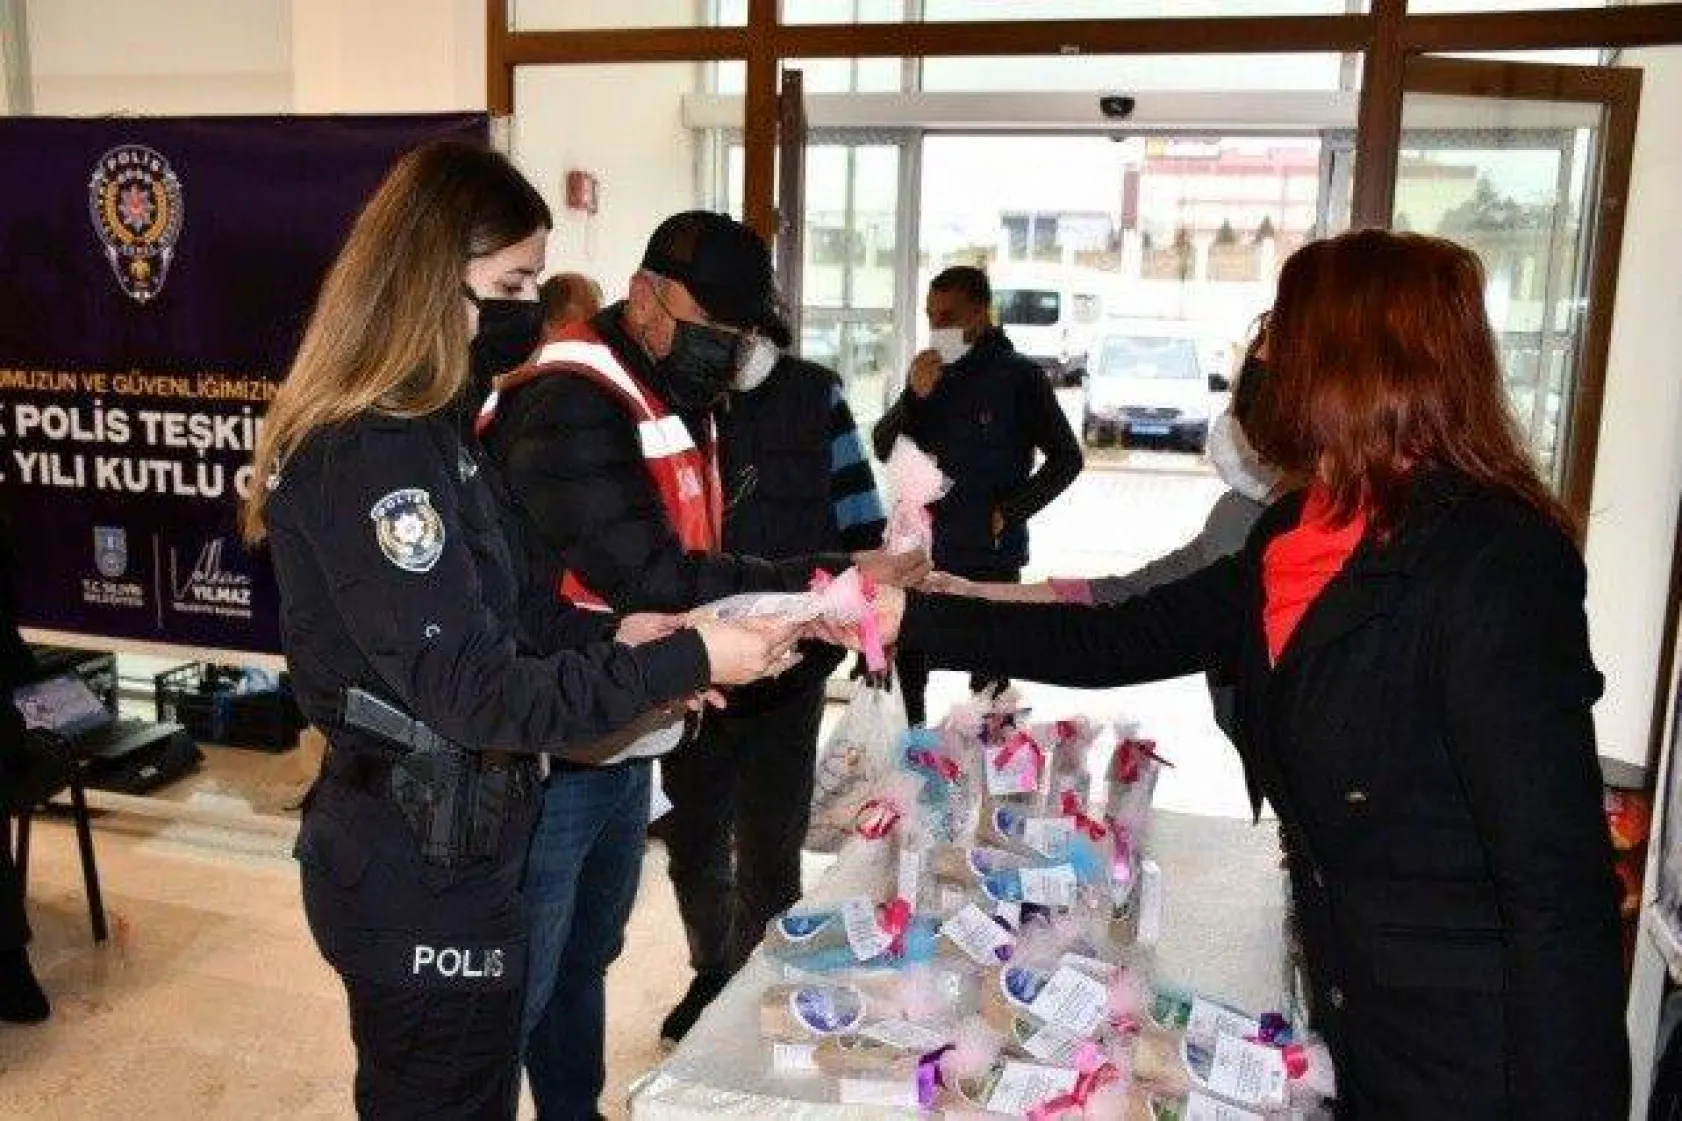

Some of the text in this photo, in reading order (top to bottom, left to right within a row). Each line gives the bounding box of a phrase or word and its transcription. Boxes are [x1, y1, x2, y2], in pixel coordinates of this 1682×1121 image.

[82, 372, 109, 394] VE
[15, 399, 130, 443] POLİS
[13, 449, 85, 488] YILI
[95, 456, 224, 498] KUTLU
